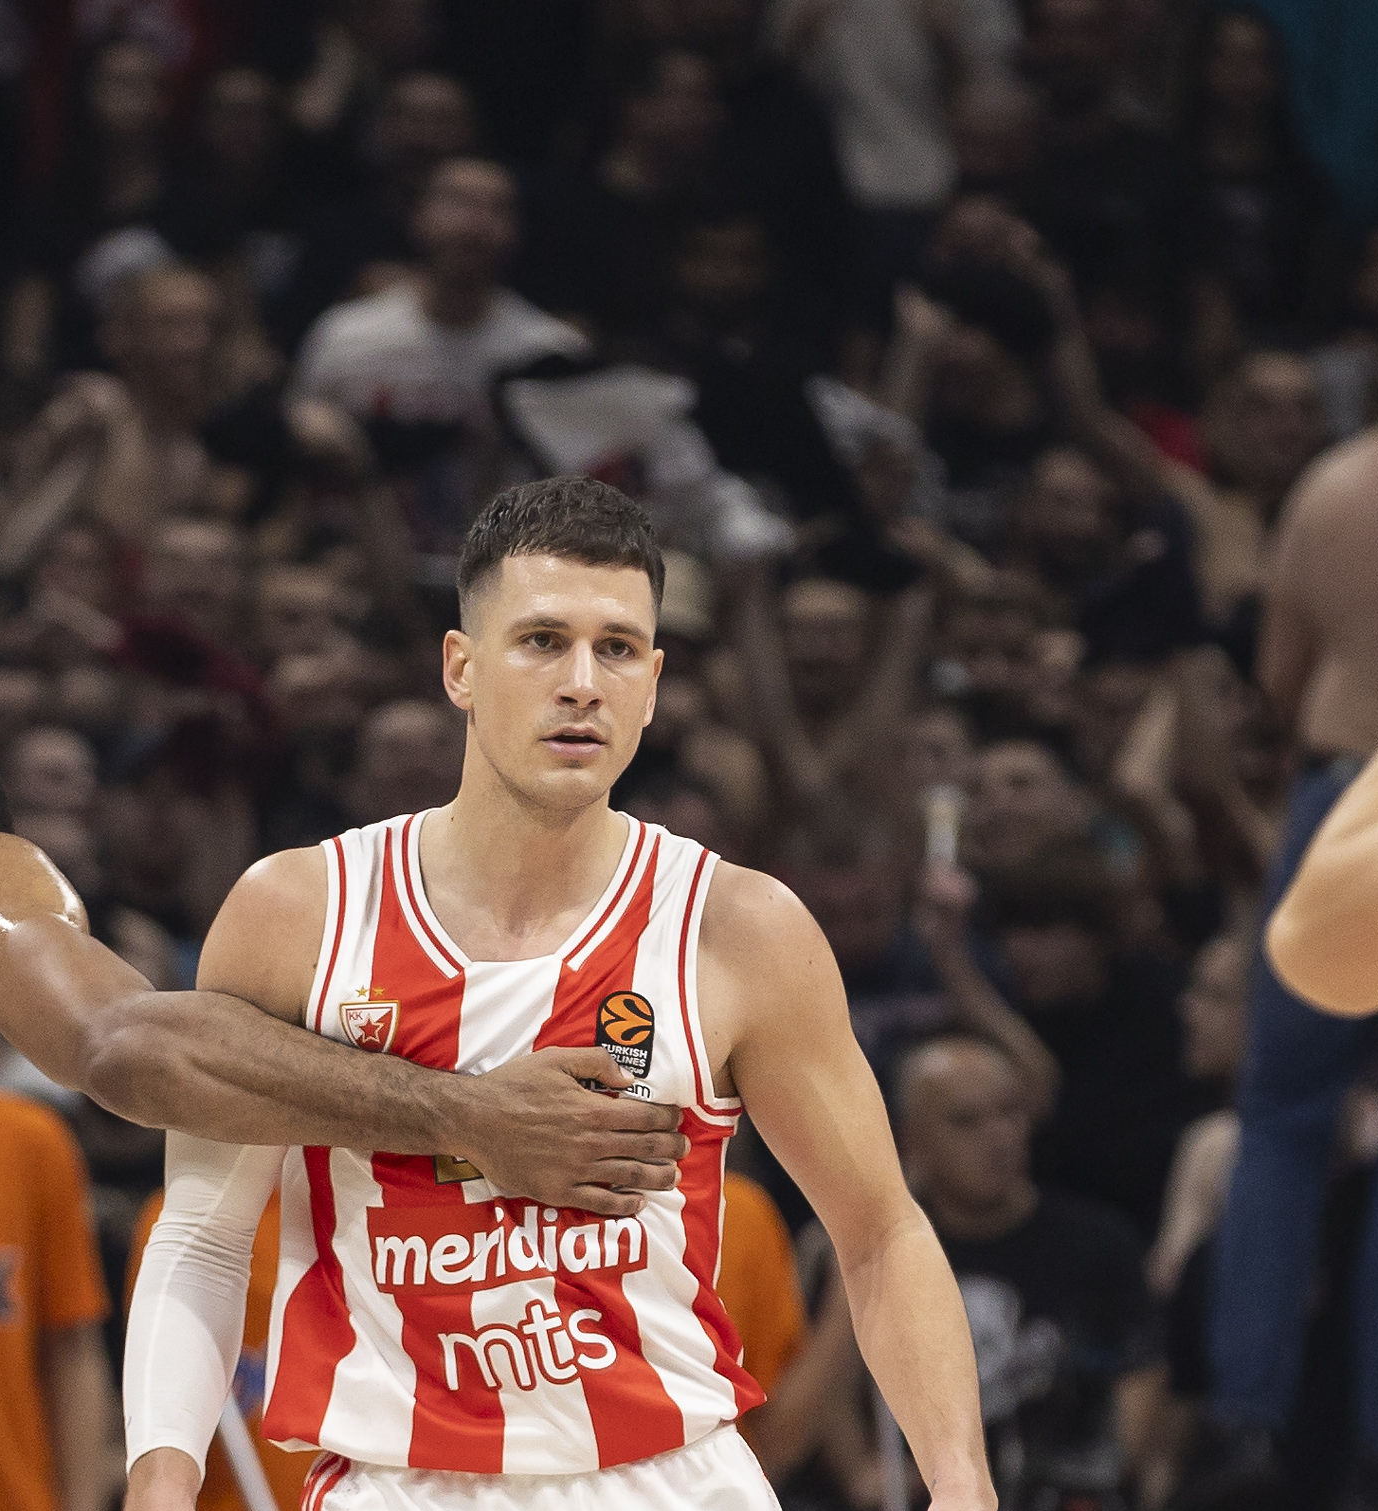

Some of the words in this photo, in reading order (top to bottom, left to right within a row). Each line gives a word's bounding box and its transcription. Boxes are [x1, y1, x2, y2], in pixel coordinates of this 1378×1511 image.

[601, 1043, 648, 1059] TURKISH
[610, 1053, 647, 1068] LINES
[375, 1207, 642, 1285] meridian
[439, 1299, 618, 1392] mts
